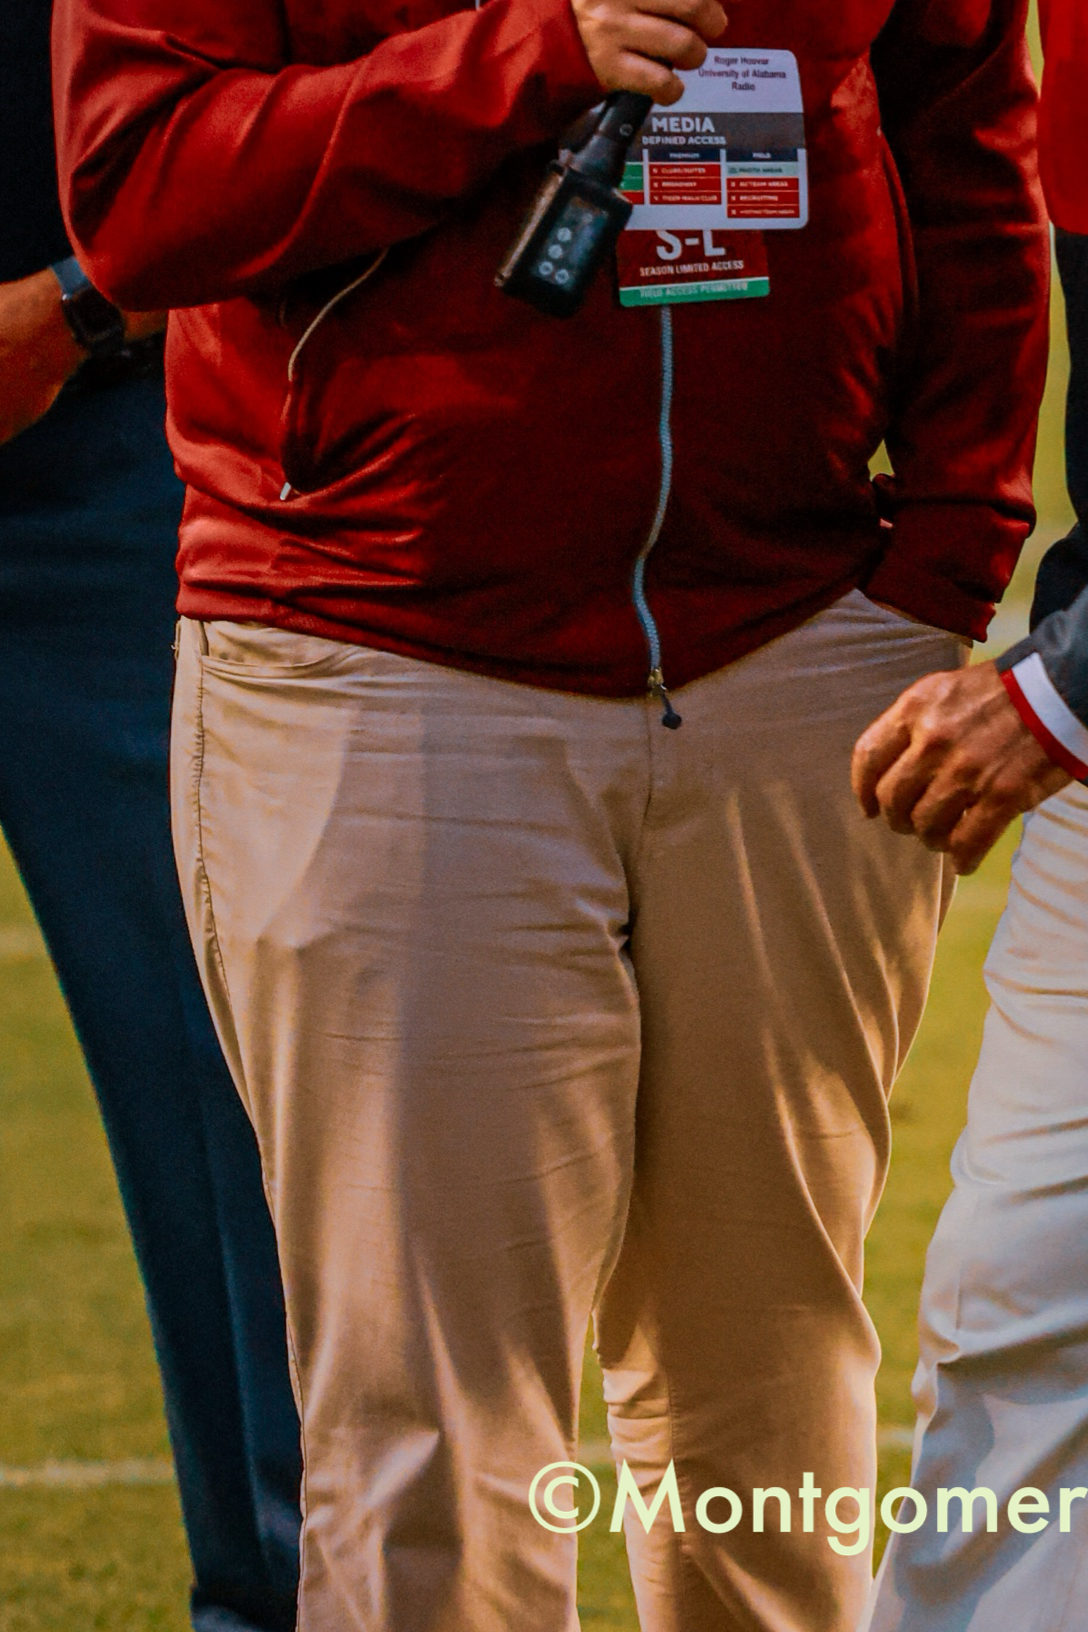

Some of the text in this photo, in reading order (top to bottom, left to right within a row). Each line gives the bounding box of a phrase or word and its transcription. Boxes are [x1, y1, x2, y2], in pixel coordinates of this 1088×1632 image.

[651, 116, 716, 133] MEDIA
[641, 135, 727, 145] DEFINED ACCESS
[639, 260, 744, 277] SEASON LIMITED ACCESS
